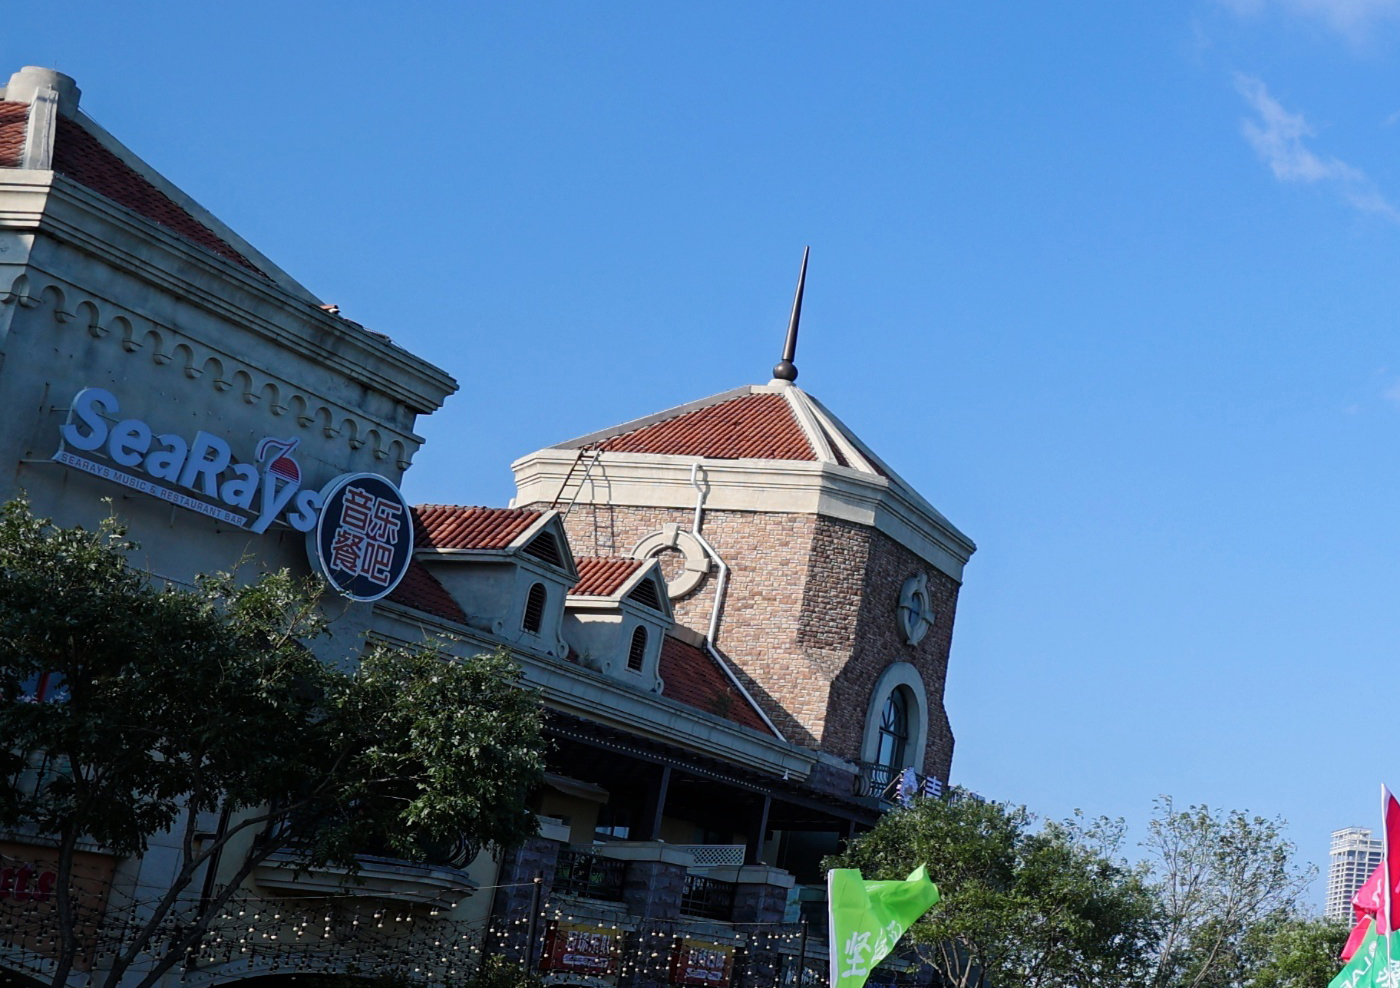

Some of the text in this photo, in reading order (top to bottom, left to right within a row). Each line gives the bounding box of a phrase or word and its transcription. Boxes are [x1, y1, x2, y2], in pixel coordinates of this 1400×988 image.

[60, 452, 244, 527] SEARAYS MUSIC & RESTAURANT BAR
[340, 486, 402, 545] 音乐
[330, 529, 396, 587] 餐吧
